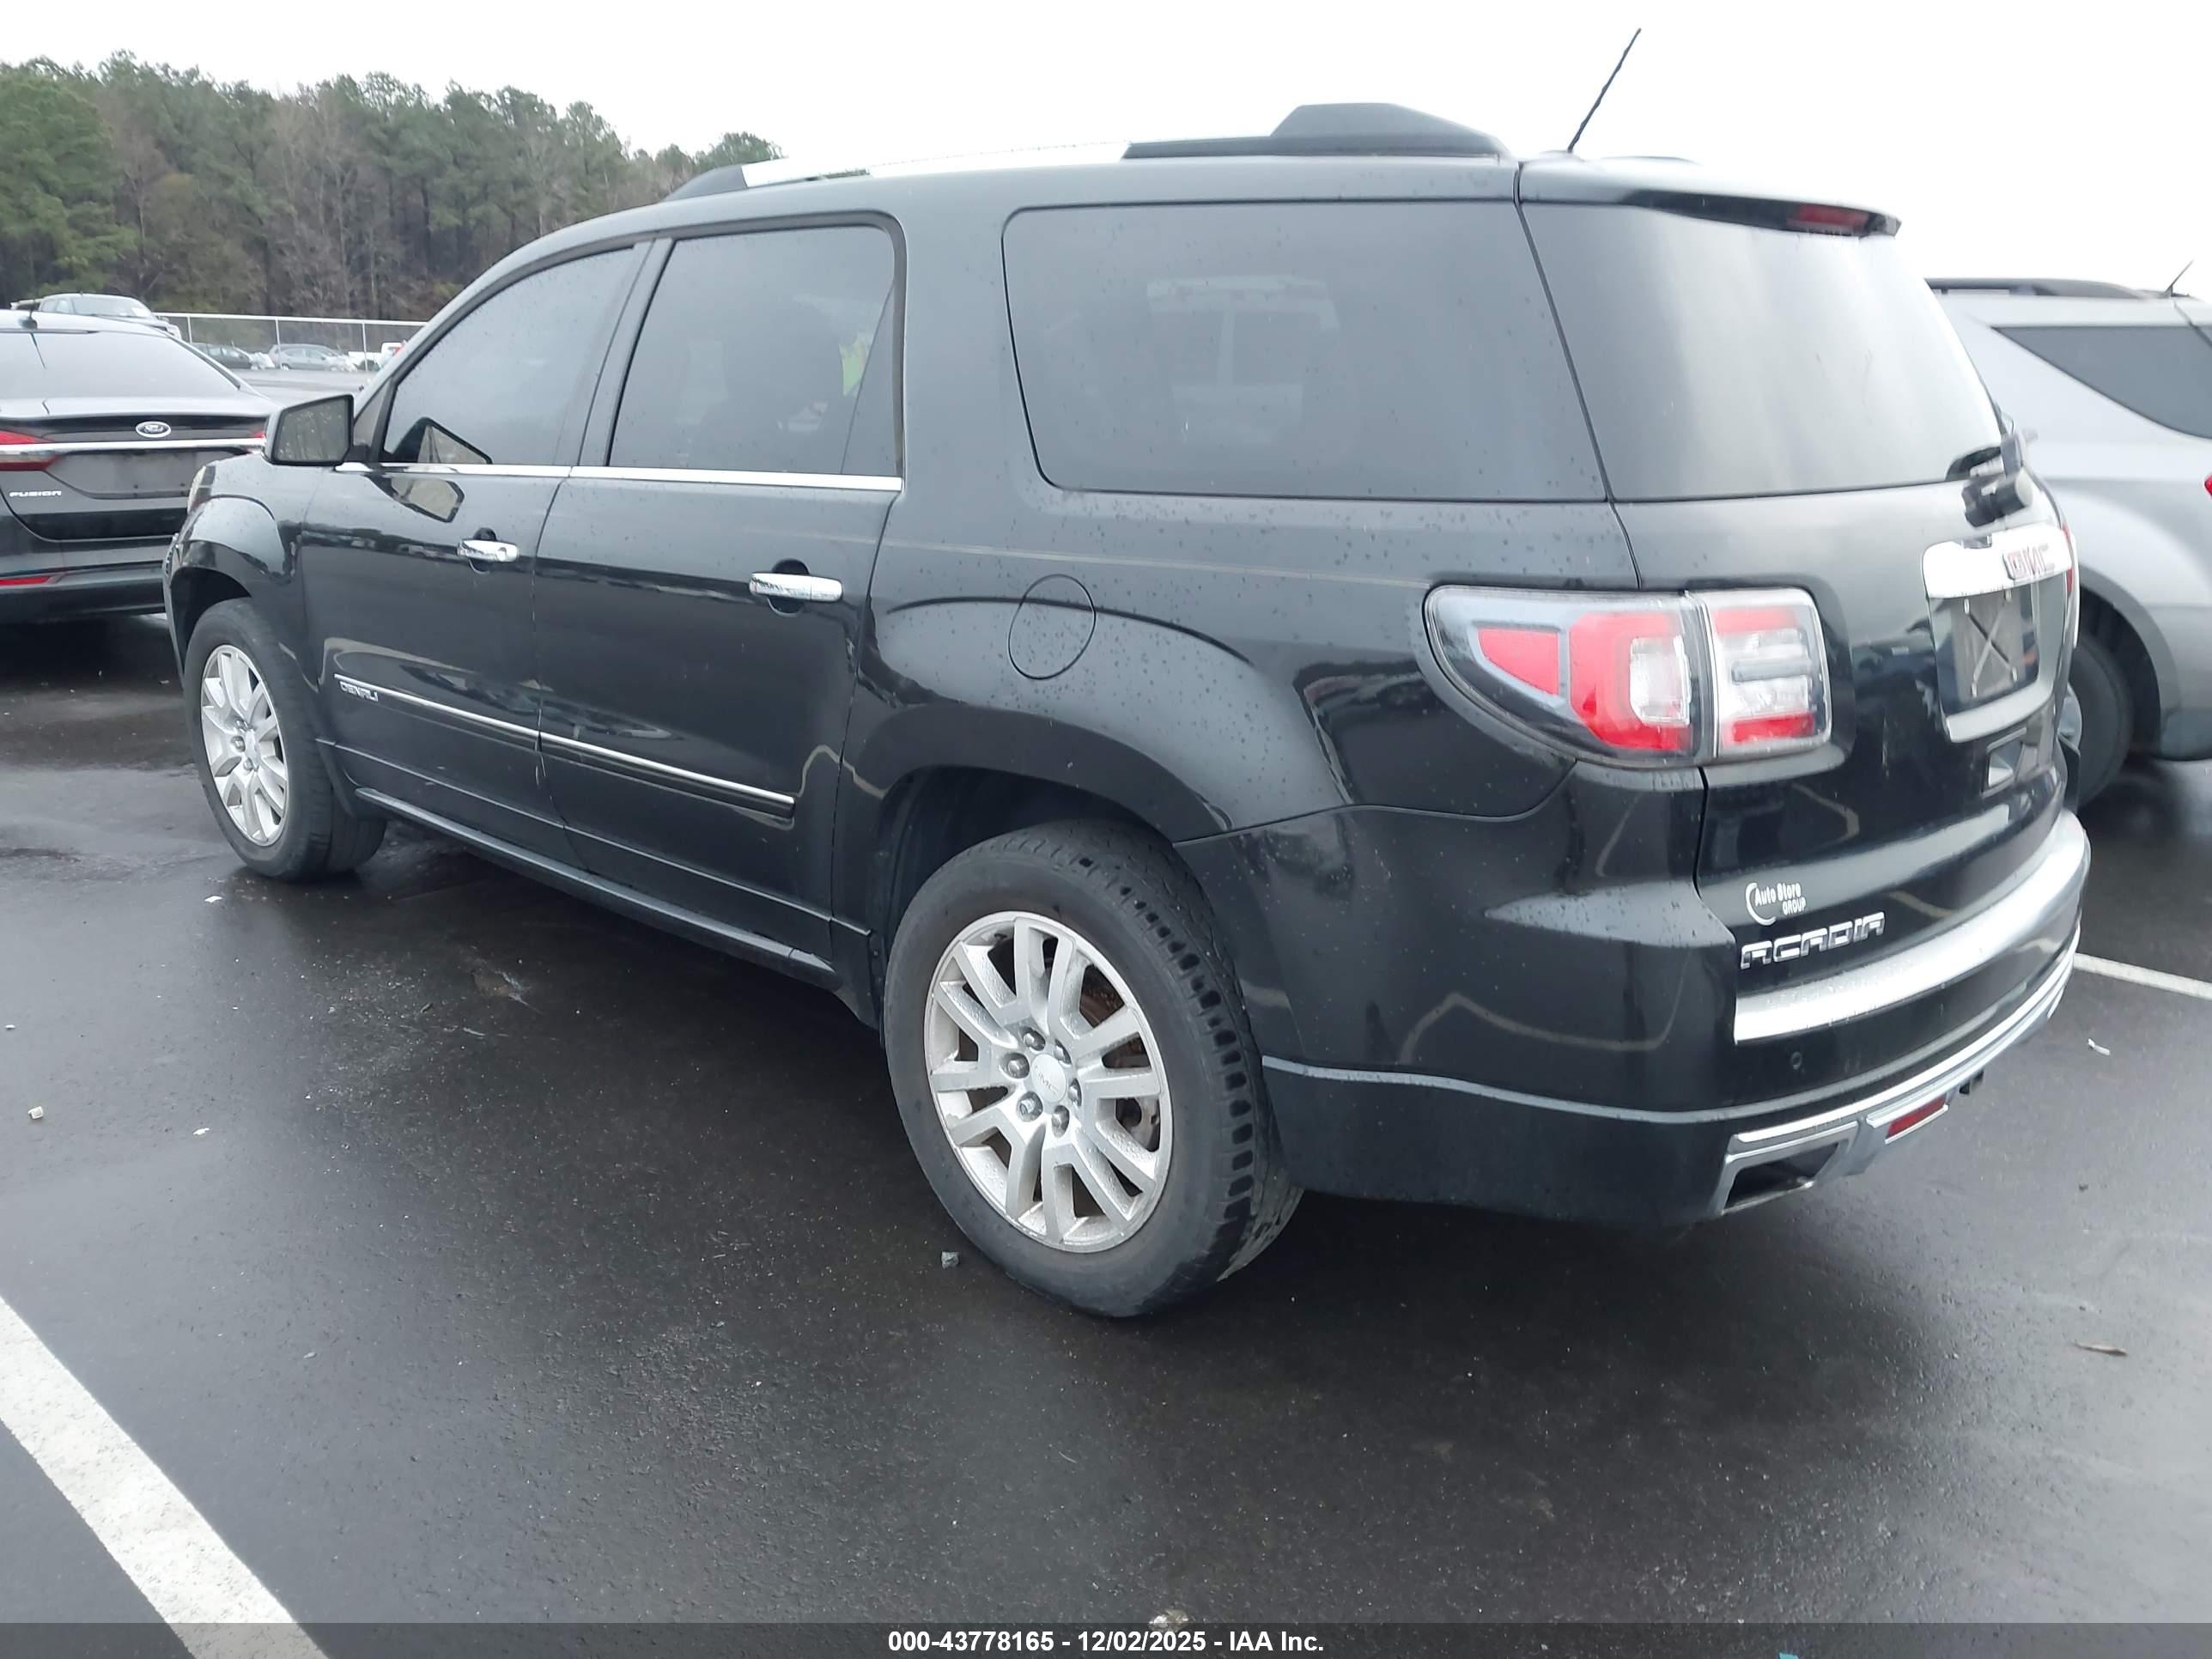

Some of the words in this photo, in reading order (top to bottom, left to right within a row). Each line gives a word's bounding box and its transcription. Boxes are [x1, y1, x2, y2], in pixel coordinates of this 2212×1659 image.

[9, 489, 63, 498] FUSION
[1753, 885, 1777, 907] Auto
[1777, 882, 1802, 902] Store
[1782, 896, 1807, 916] GROUP
[1740, 910, 1886, 970] ACADIA
